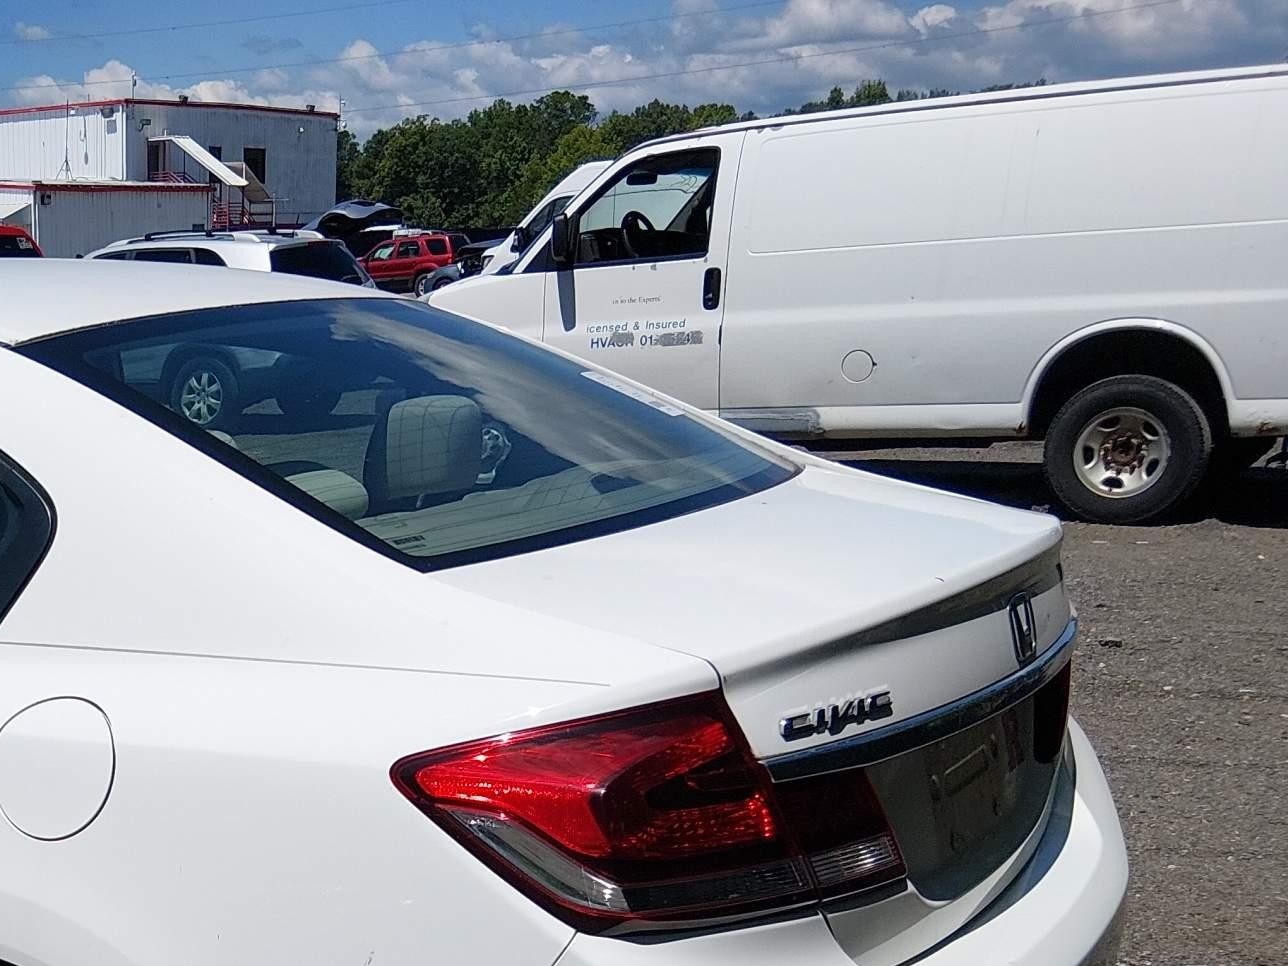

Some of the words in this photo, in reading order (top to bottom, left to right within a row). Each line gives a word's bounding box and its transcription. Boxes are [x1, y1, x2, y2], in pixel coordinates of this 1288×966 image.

[632, 321, 640, 331] &
[645, 318, 687, 330] Insured
[778, 688, 893, 742] CIVIC
